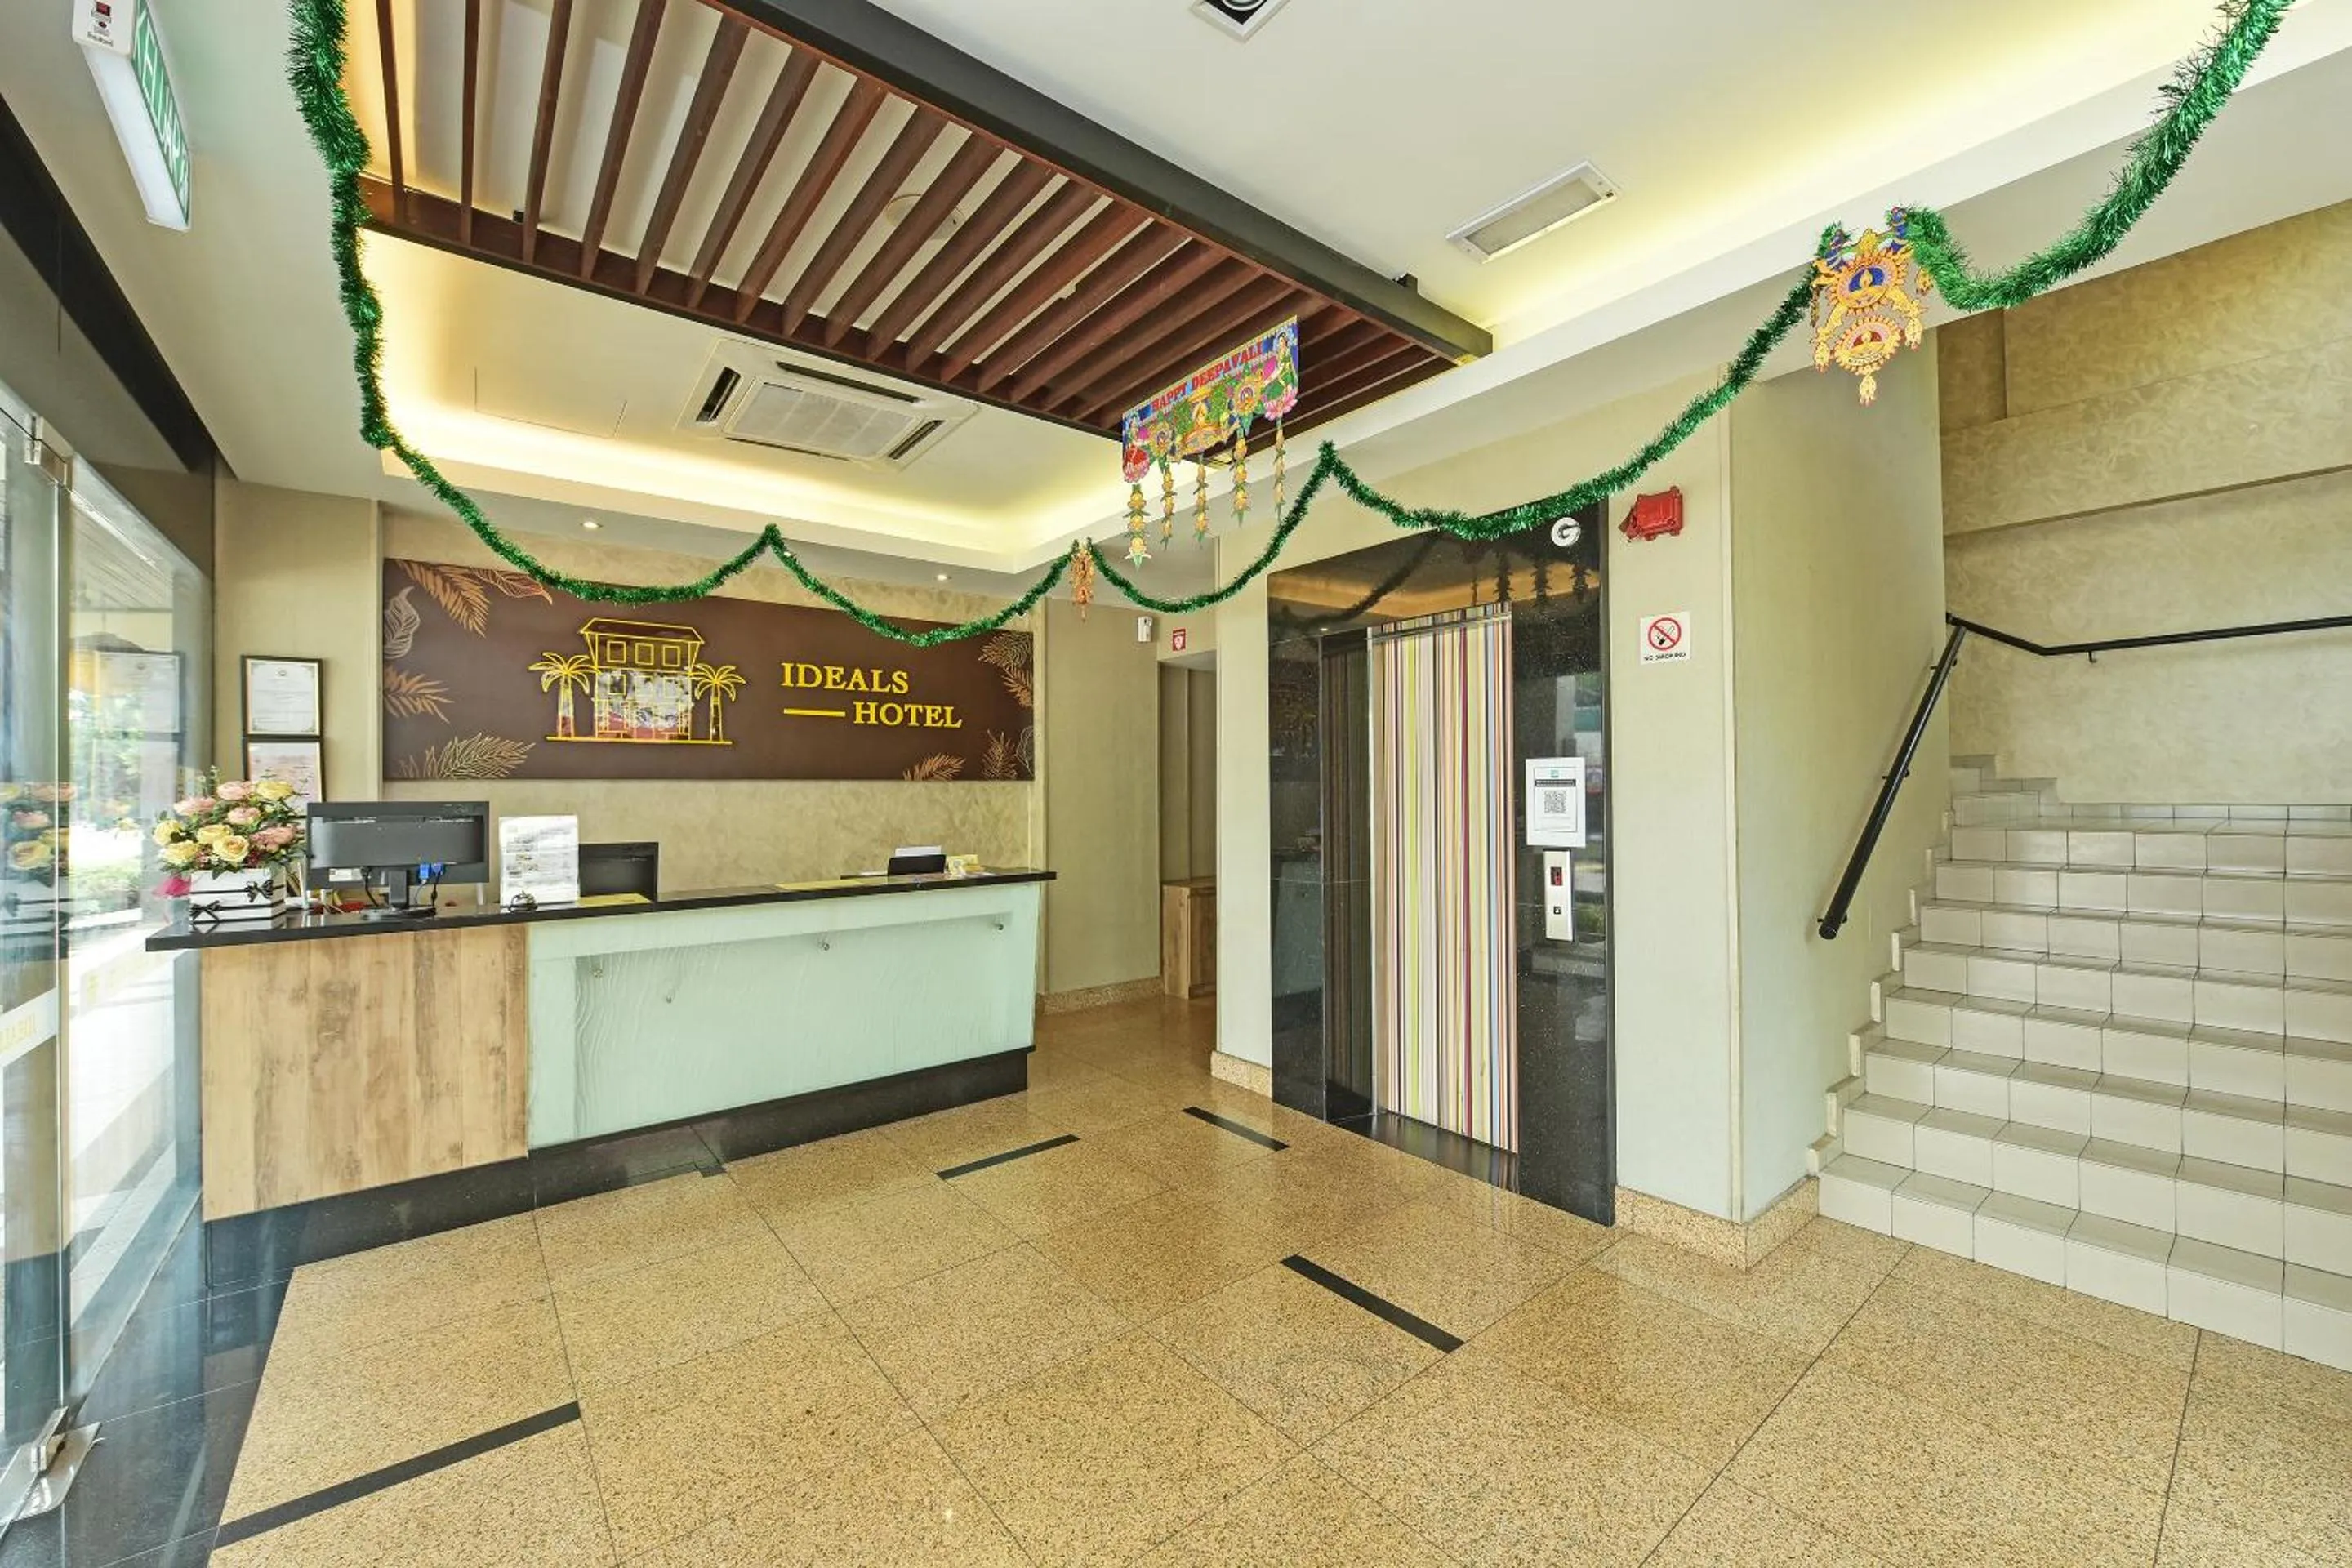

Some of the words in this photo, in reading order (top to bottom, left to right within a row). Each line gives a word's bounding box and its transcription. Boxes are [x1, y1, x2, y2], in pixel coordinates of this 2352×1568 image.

[1152, 382, 1187, 411] HAPPY
[1192, 341, 1263, 390] DEEPAVALI
[1551, 517, 1581, 546] G
[781, 662, 909, 694] IDEALS
[853, 701, 963, 728] HOTEL
